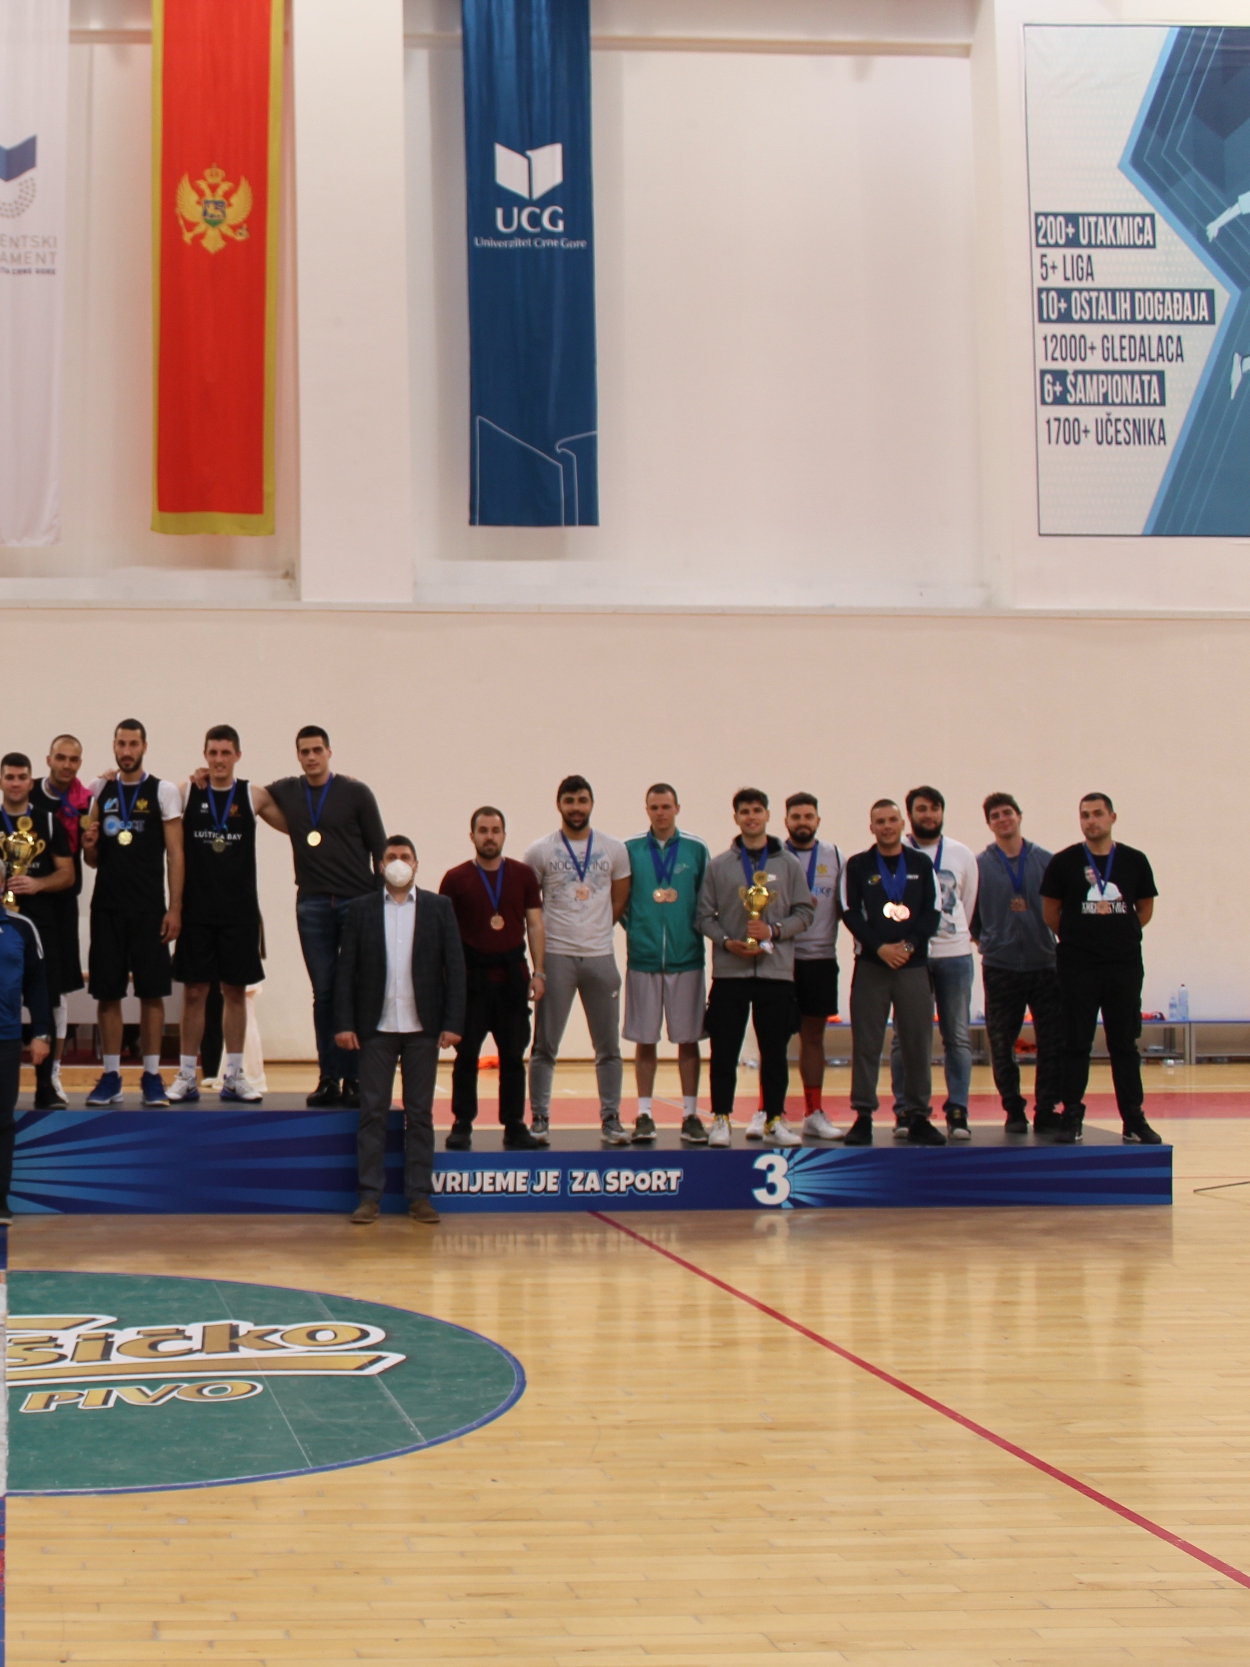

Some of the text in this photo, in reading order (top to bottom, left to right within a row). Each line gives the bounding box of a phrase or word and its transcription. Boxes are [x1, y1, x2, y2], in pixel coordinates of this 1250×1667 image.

[495, 206, 564, 233] UCG
[1037, 215, 1154, 246] 200+ UTAKMICA
[1040, 254, 1094, 282] 5+ LIGA
[1041, 290, 1209, 321] 10+ OSTALIH DOGAĐAJA
[1043, 334, 1184, 362] 12000+ GLEDALACA
[1043, 369, 1160, 404] 6+ ŠAMPIONATA
[1046, 411, 1166, 446] 1700+ UČESNIKA
[431, 1171, 682, 1193] VRIJEME JE ZA SPORT
[752, 1154, 790, 1205] 3
[20, 1381, 263, 1413] PIVO
